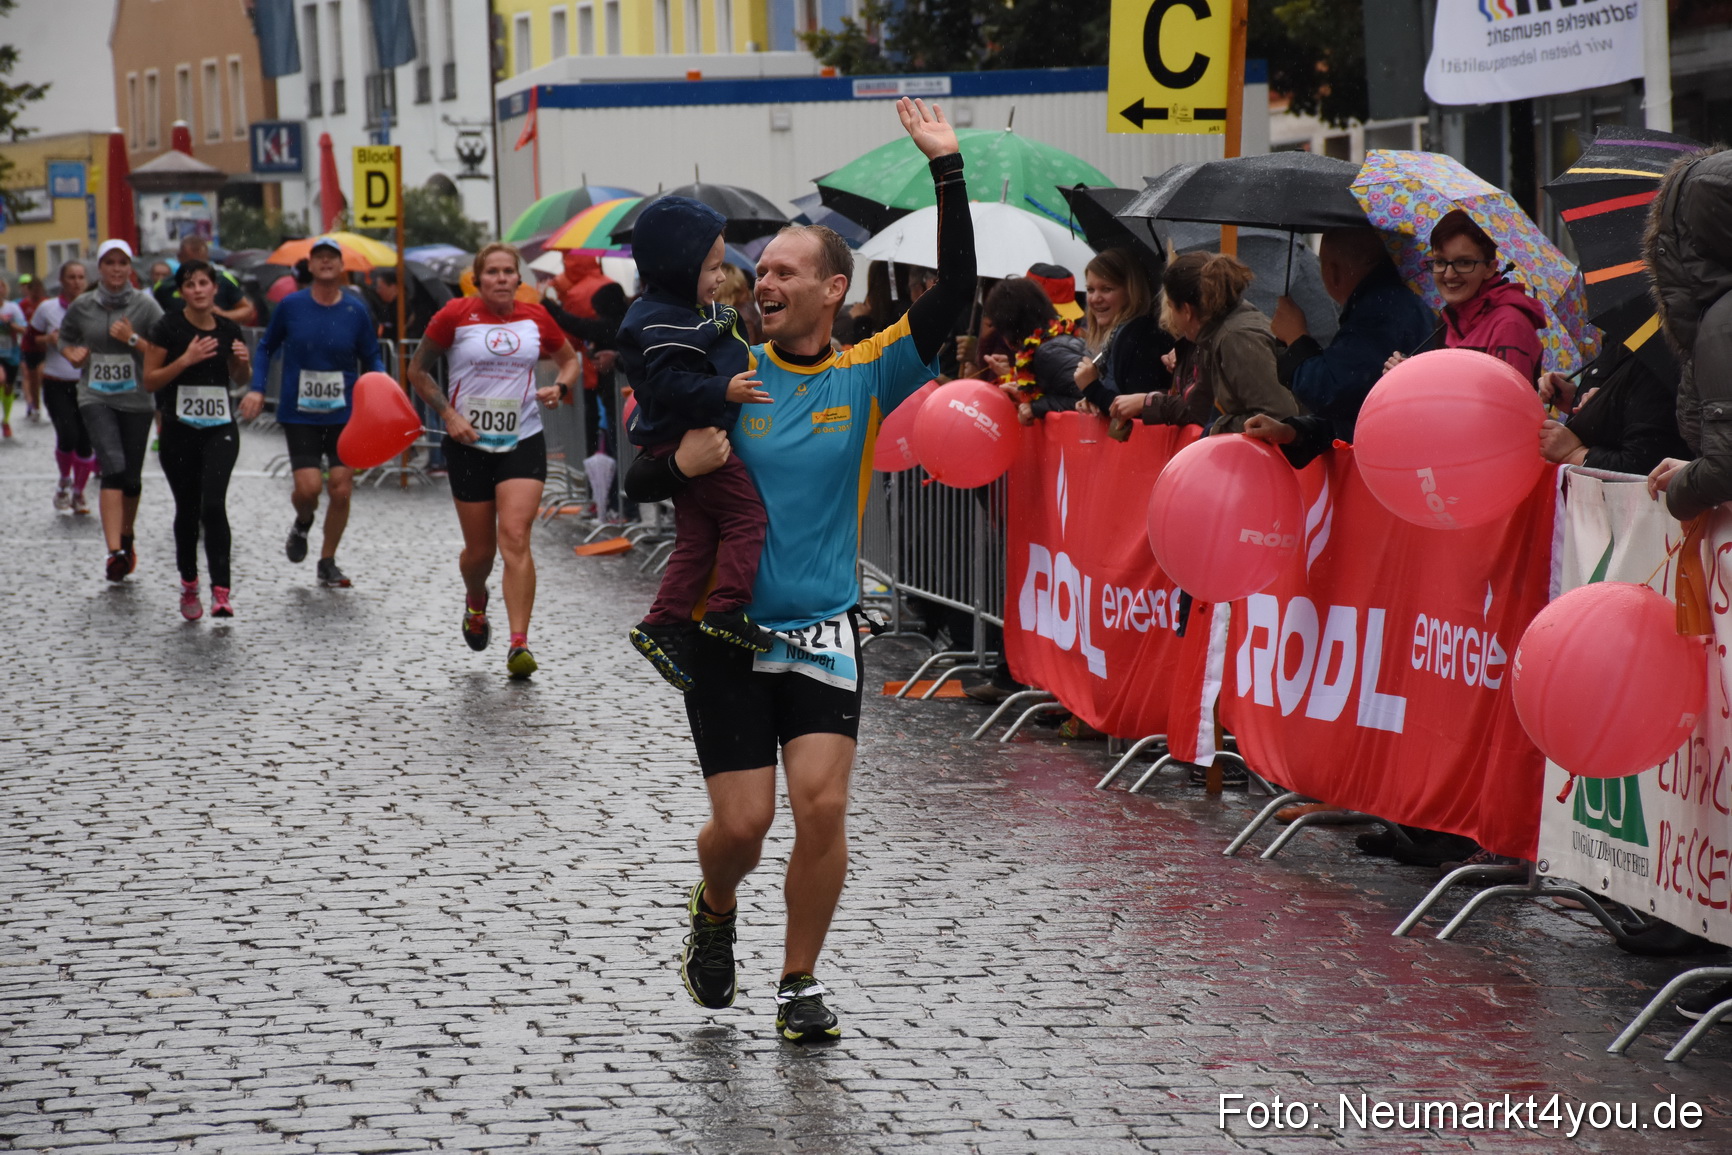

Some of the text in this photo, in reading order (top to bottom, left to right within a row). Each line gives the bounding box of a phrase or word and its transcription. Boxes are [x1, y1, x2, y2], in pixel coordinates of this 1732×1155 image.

[1143, 0, 1212, 90] C
[357, 148, 397, 164] Block
[366, 170, 390, 209] D
[94, 364, 132, 381] 2838
[303, 381, 341, 399] 3045
[182, 398, 226, 417] 2305
[470, 409, 517, 432] 2030
[749, 417, 767, 431] 10
[786, 644, 836, 671] Norbert
[1656, 820, 1732, 910] BESSE
